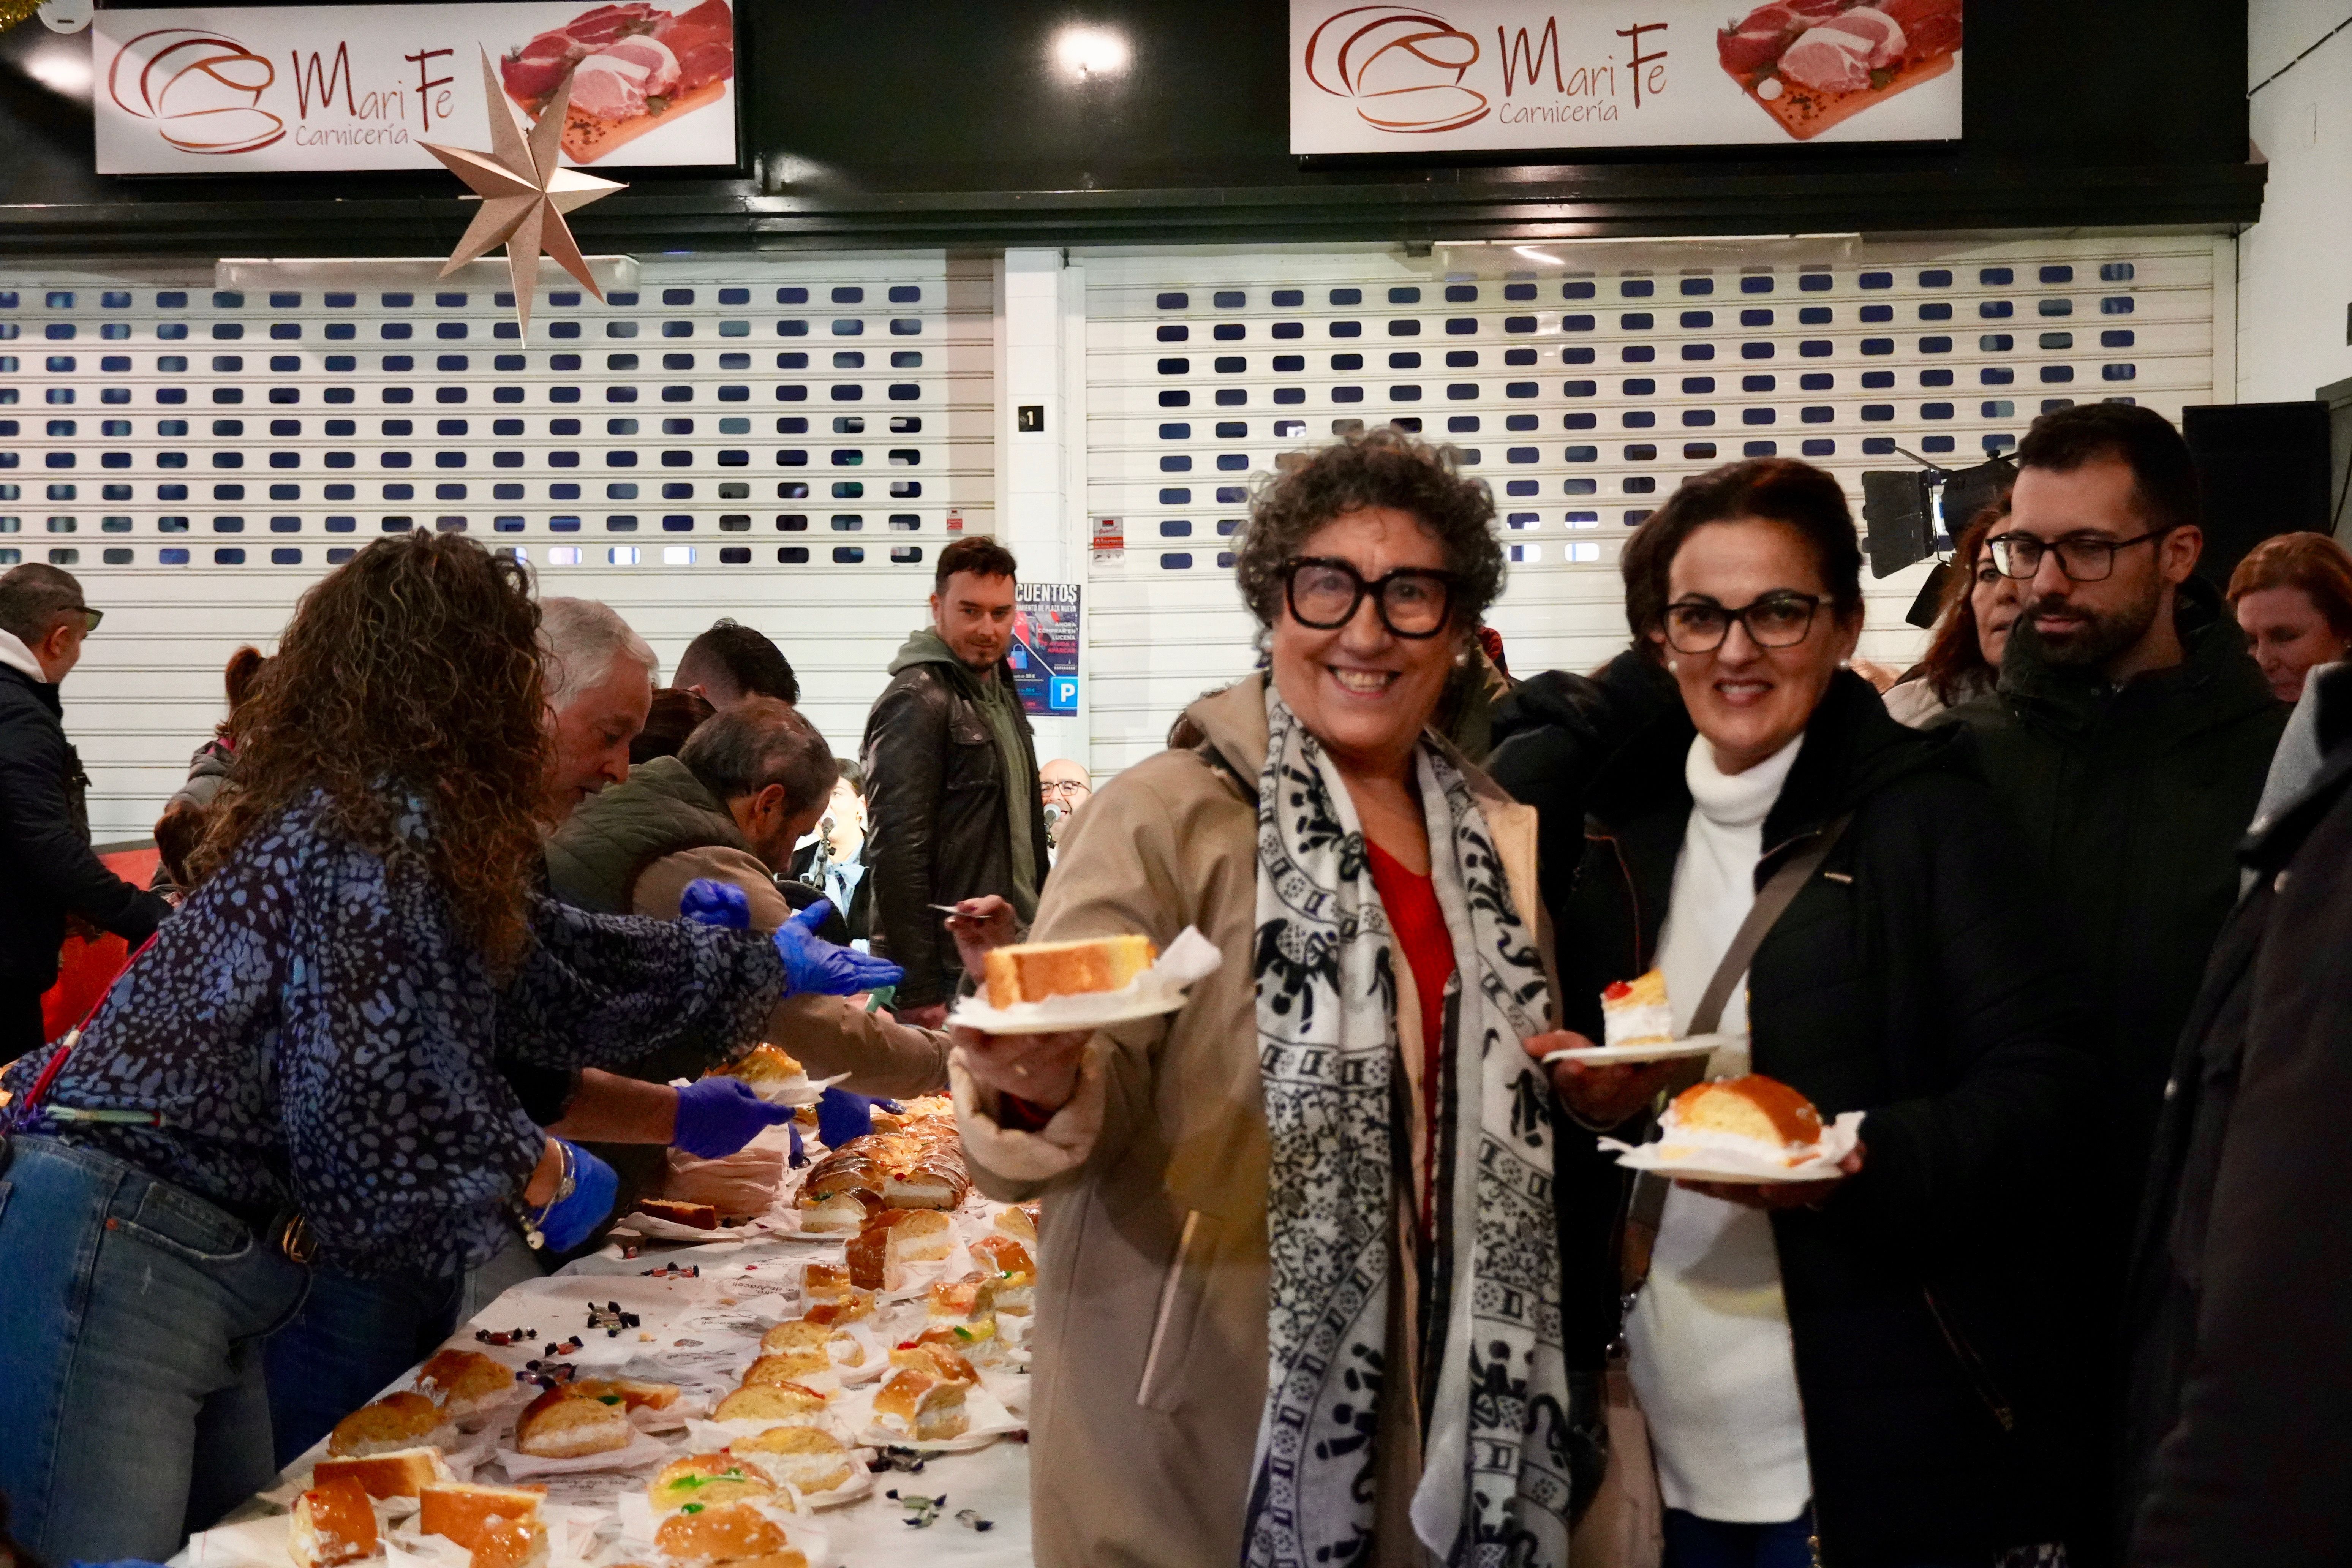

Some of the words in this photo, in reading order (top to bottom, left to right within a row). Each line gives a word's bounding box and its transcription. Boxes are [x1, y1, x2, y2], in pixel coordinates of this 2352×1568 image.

[1500, 100, 1618, 123] Carnicería
[296, 123, 408, 146] Carnicería
[1027, 411, 1034, 425] 1
[1060, 683, 1075, 702] P
[733, 1282, 767, 1291] Araceli
